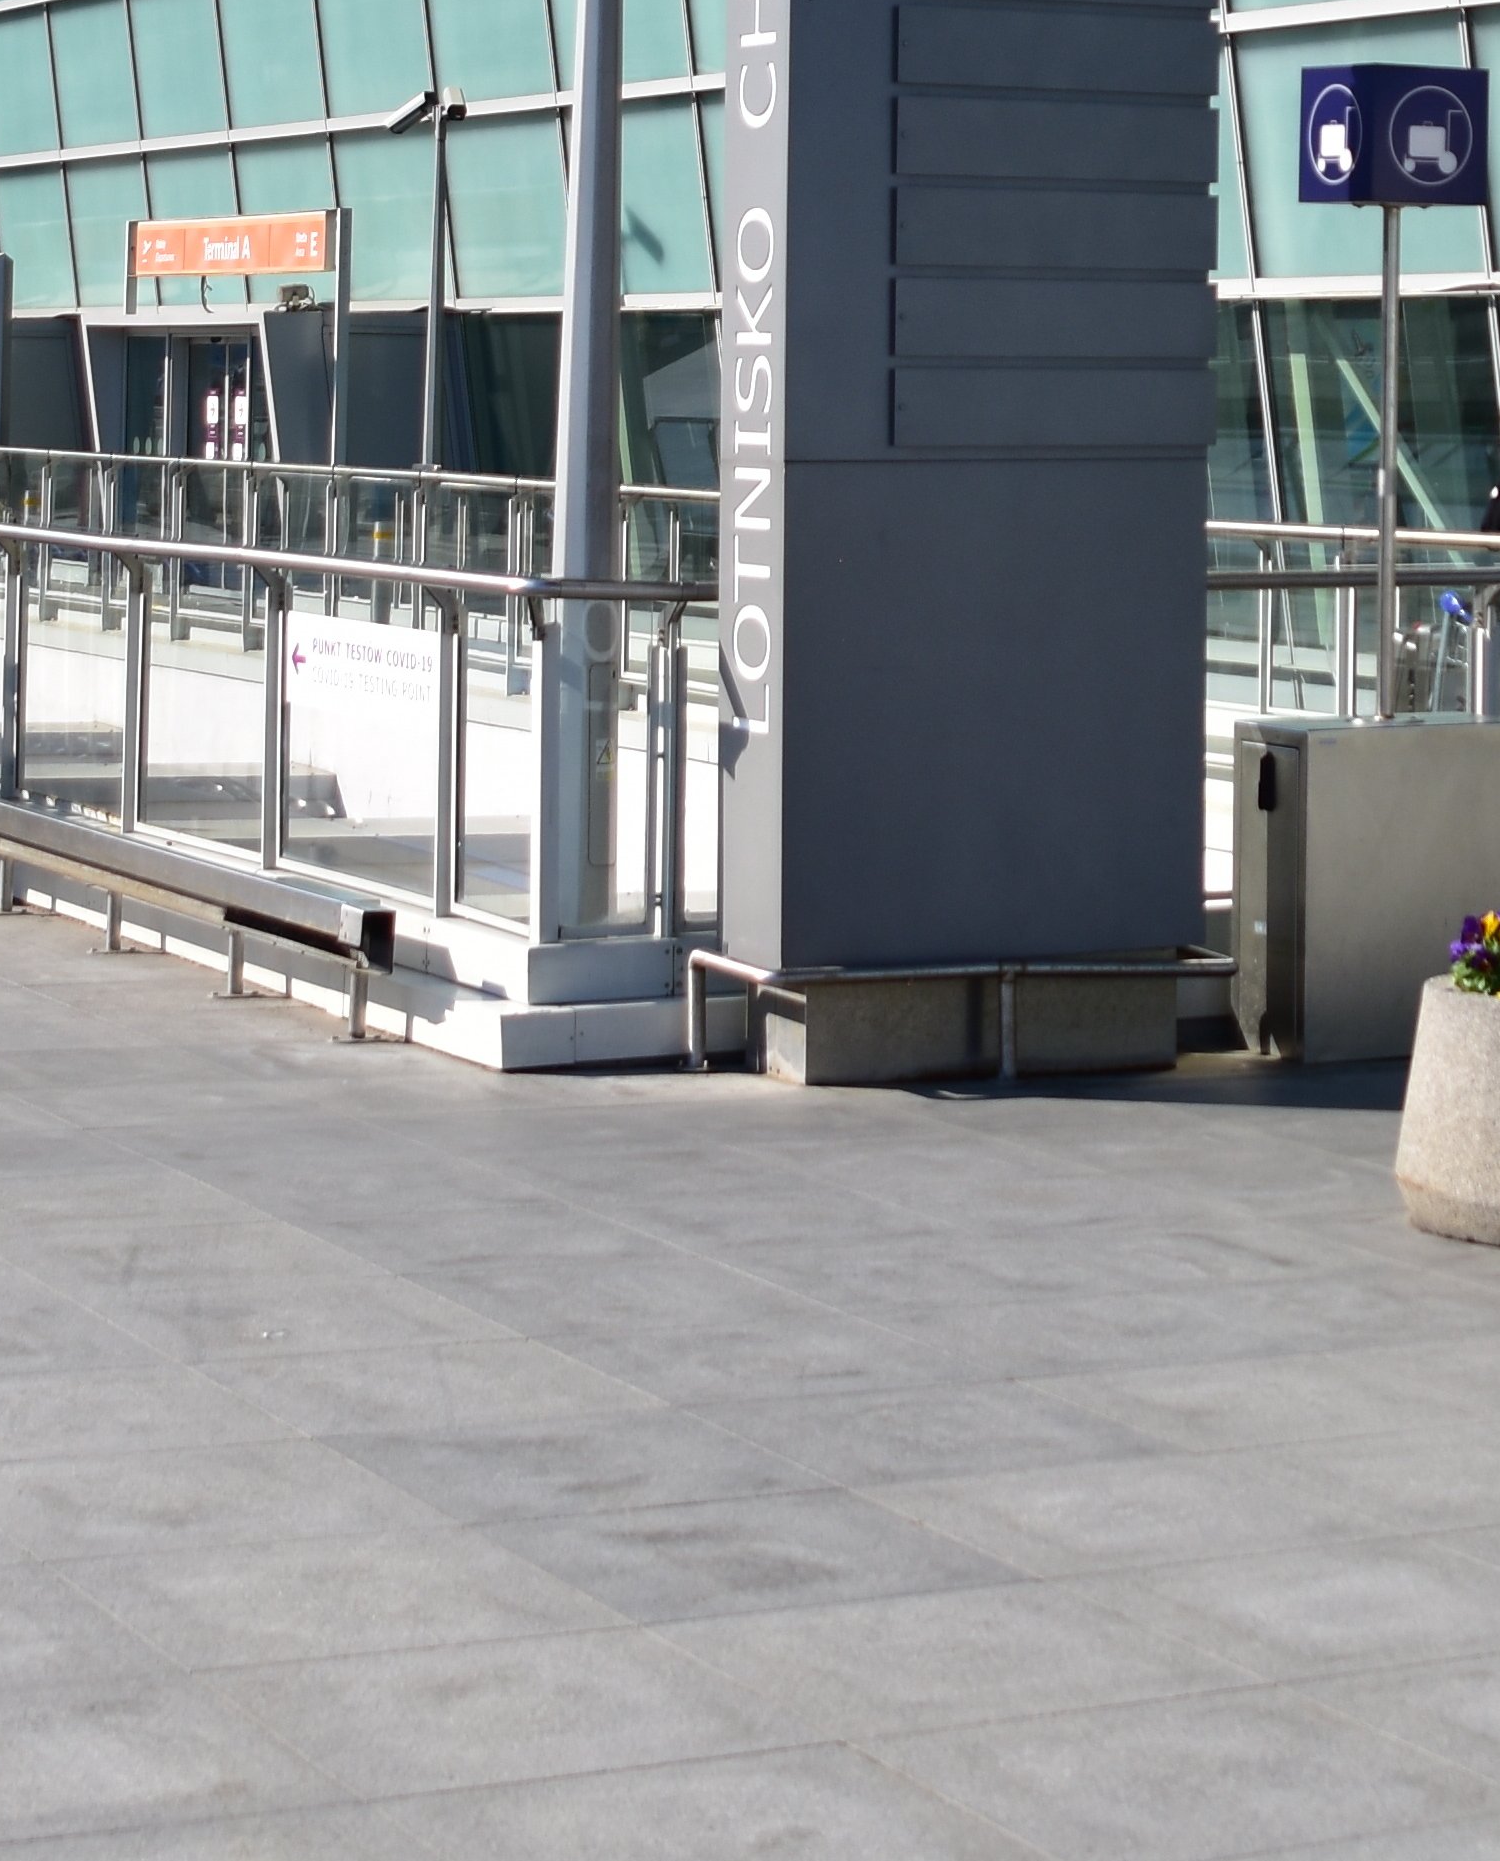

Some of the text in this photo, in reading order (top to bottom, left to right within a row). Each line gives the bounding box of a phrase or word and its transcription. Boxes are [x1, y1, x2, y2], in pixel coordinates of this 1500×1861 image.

[732, 206, 775, 736] LOTNISKO
[312, 637, 341, 657] PUNKT
[386, 649, 433, 673] COVID-19
